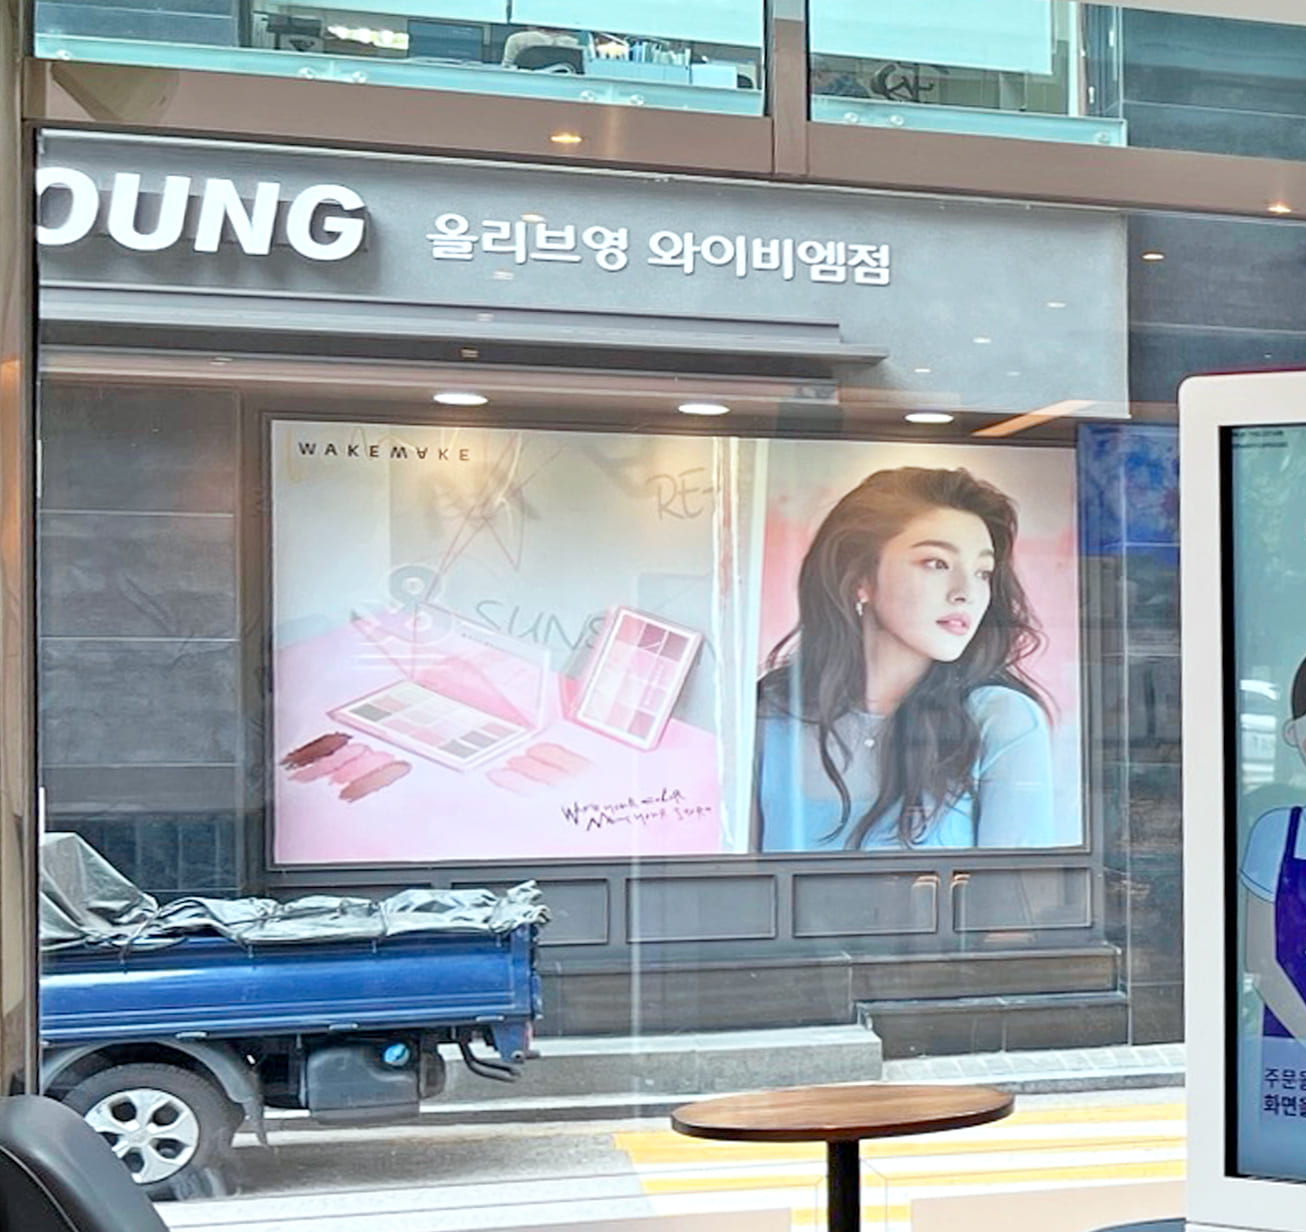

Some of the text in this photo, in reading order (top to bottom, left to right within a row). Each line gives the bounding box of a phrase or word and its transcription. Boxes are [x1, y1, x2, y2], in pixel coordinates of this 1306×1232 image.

[36, 166, 368, 261] OUNG
[426, 213, 893, 287] 올리브영 와이비엠점
